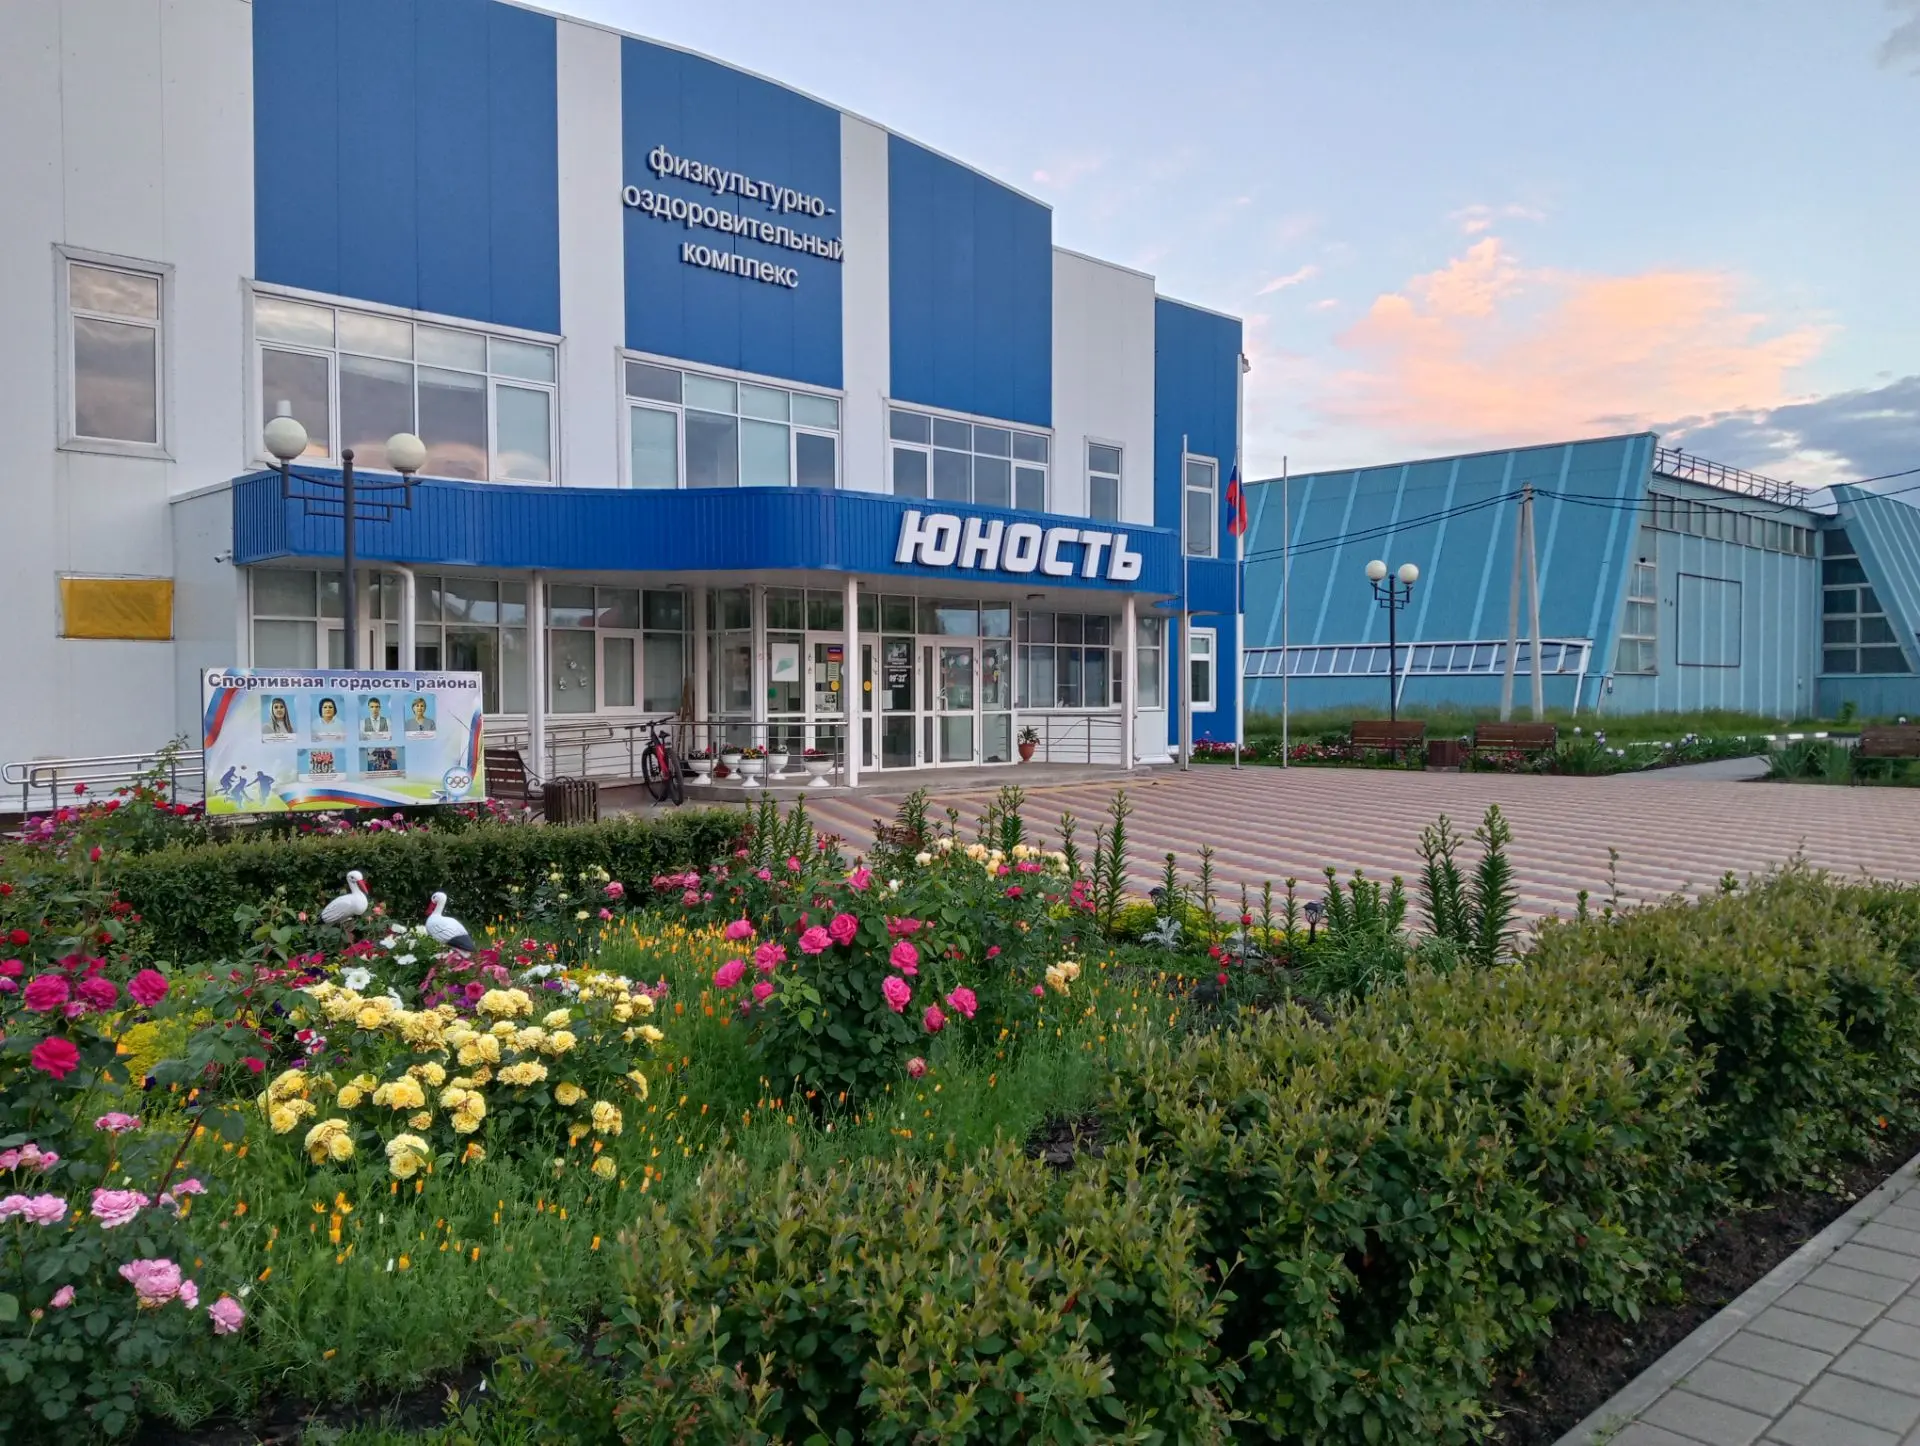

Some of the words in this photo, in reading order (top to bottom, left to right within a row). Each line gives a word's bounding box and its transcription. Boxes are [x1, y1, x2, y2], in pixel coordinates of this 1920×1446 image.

[649, 145, 836, 217] физкультурно-
[622, 185, 845, 261] оздоровительный
[682, 242, 799, 288] комплекс
[895, 510, 1143, 581] ЮНОСТЬ
[208, 673, 324, 690] Спортивная
[330, 677, 410, 691] гордость
[416, 676, 477, 690] района
